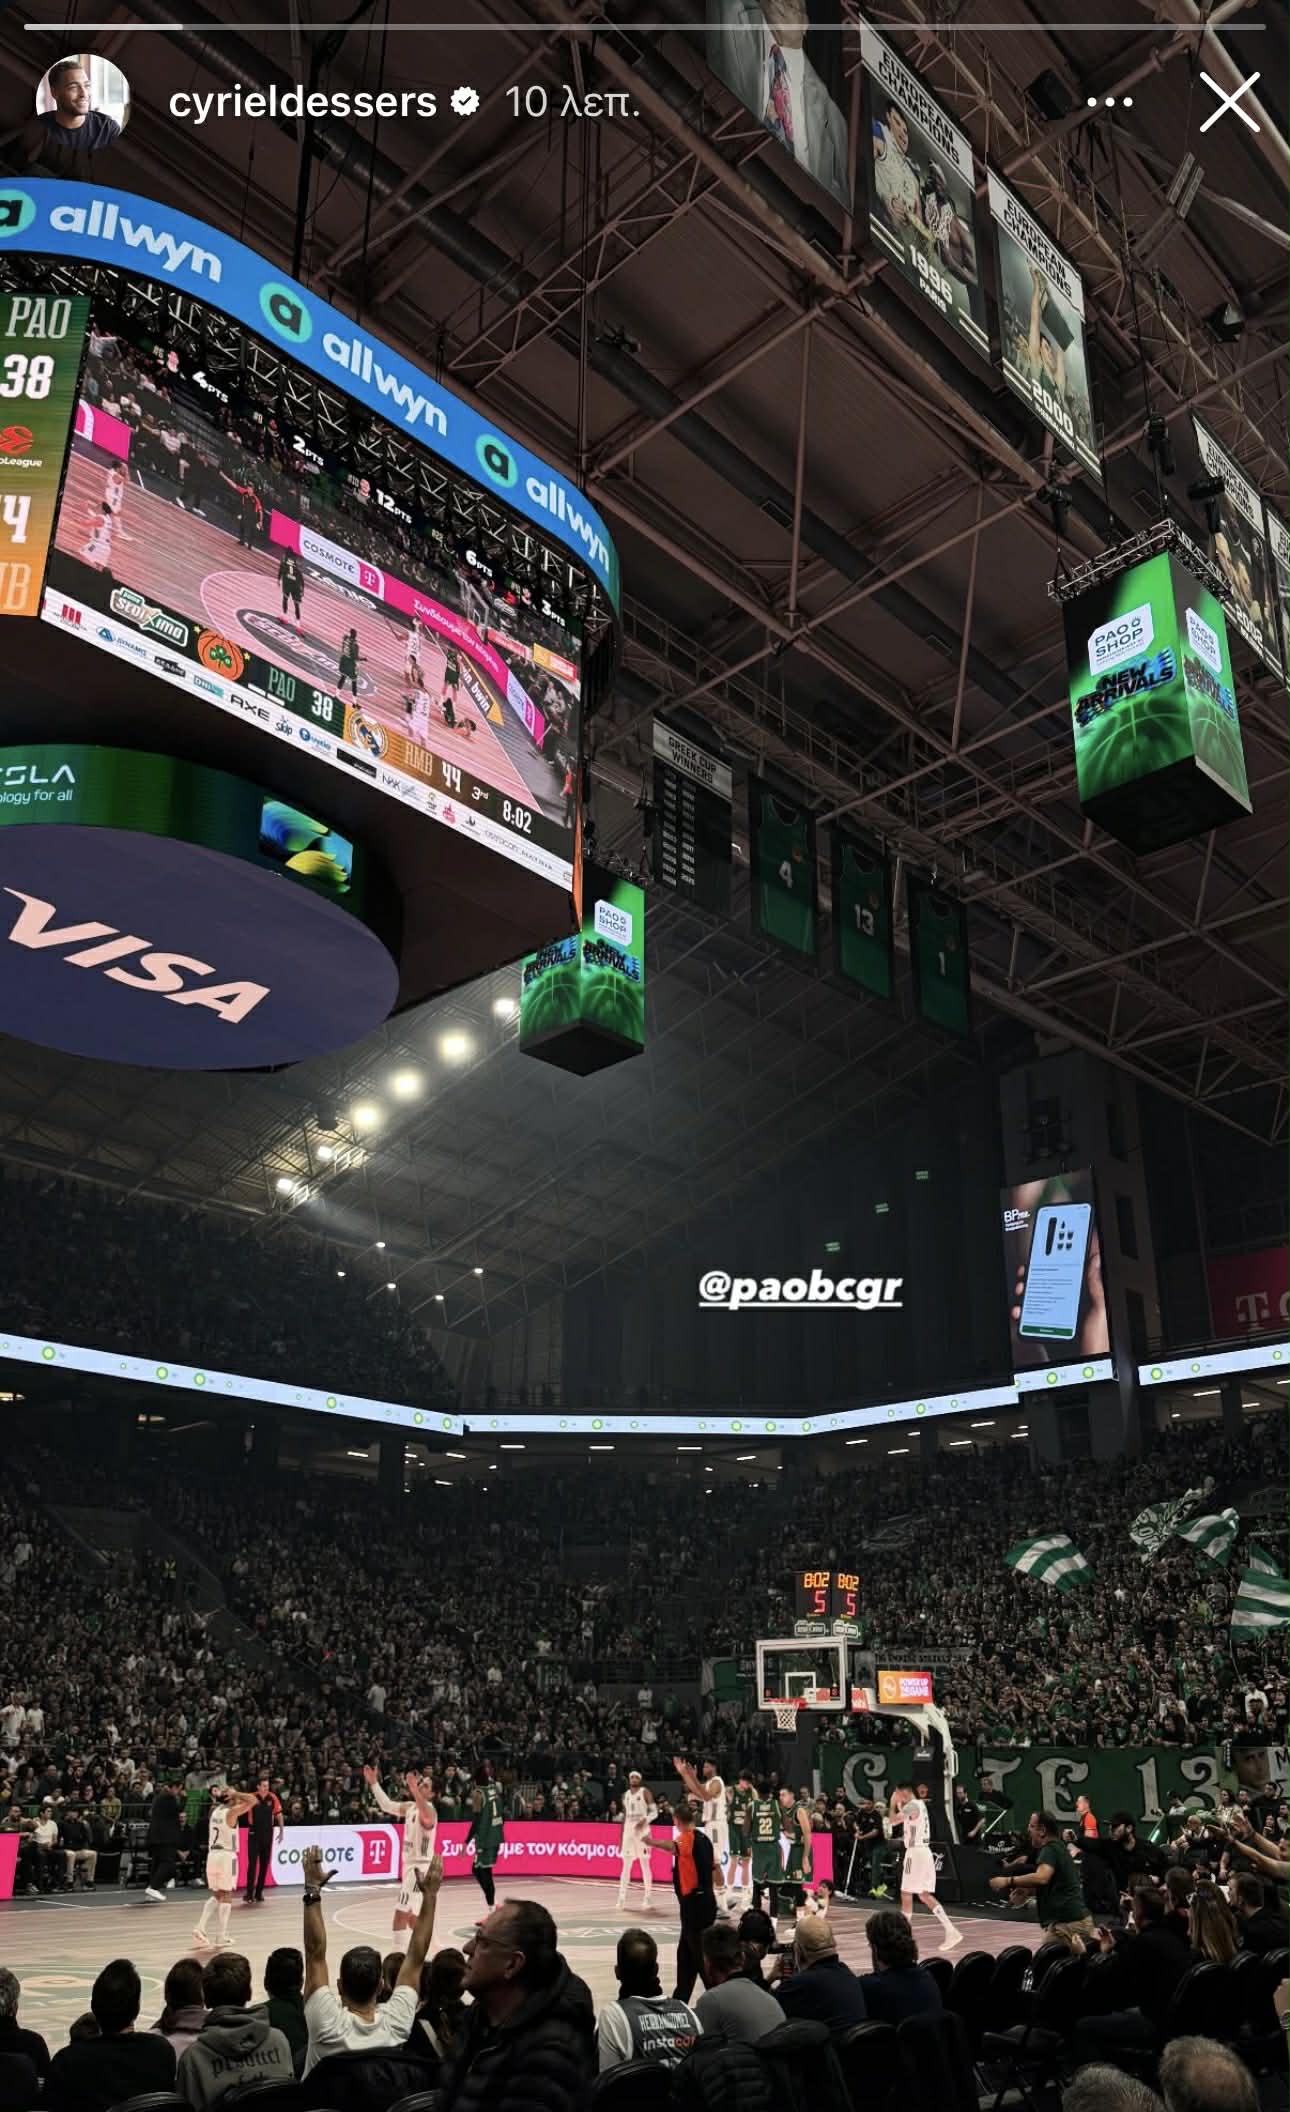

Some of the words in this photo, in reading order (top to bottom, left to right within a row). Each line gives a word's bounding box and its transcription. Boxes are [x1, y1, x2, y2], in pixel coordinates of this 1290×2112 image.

[879, 61, 960, 164] CHAMPIONS
[883, 51, 953, 145] EUROPEAN
[50, 200, 222, 284] allwyn
[1003, 208, 1072, 297] CHAMPIONS
[1007, 199, 1067, 280] EUROPEAN
[910, 244, 952, 305] 1996
[5, 297, 72, 339] PAO
[0, 353, 55, 400] 38
[321, 332, 448, 439] allwyn
[1031, 378, 1074, 438] 2000
[525, 477, 610, 573] allwyn
[1095, 624, 1129, 647] PAO
[1095, 628, 1143, 657] SHOP
[268, 667, 296, 702] PAO
[311, 691, 334, 721] 38
[1076, 666, 1174, 712] ARRIVALS
[1099, 661, 1147, 689] NEW
[230, 694, 271, 722] AXE
[669, 736, 697, 761] GREEK
[671, 749, 713, 785] WINNERS
[34, 788, 55, 801] for
[57, 789, 73, 801] all
[441, 760, 462, 793] 44
[471, 785, 489, 801] 3rd
[502, 799, 532, 834] 8:02
[779, 860, 793, 889] 4
[855, 903, 874, 937] 13
[3, 887, 272, 1024] VISA
[804, 1572, 830, 1588] 8:02
[837, 1573, 859, 1591] 8:02
[814, 1590, 826, 1613] 5
[846, 1593, 856, 1616] 5
[841, 1751, 1090, 1823] GTE
[758, 1817, 773, 1836] 22
[527, 1842, 554, 1856] τον
[558, 1840, 606, 1861] κόσμο
